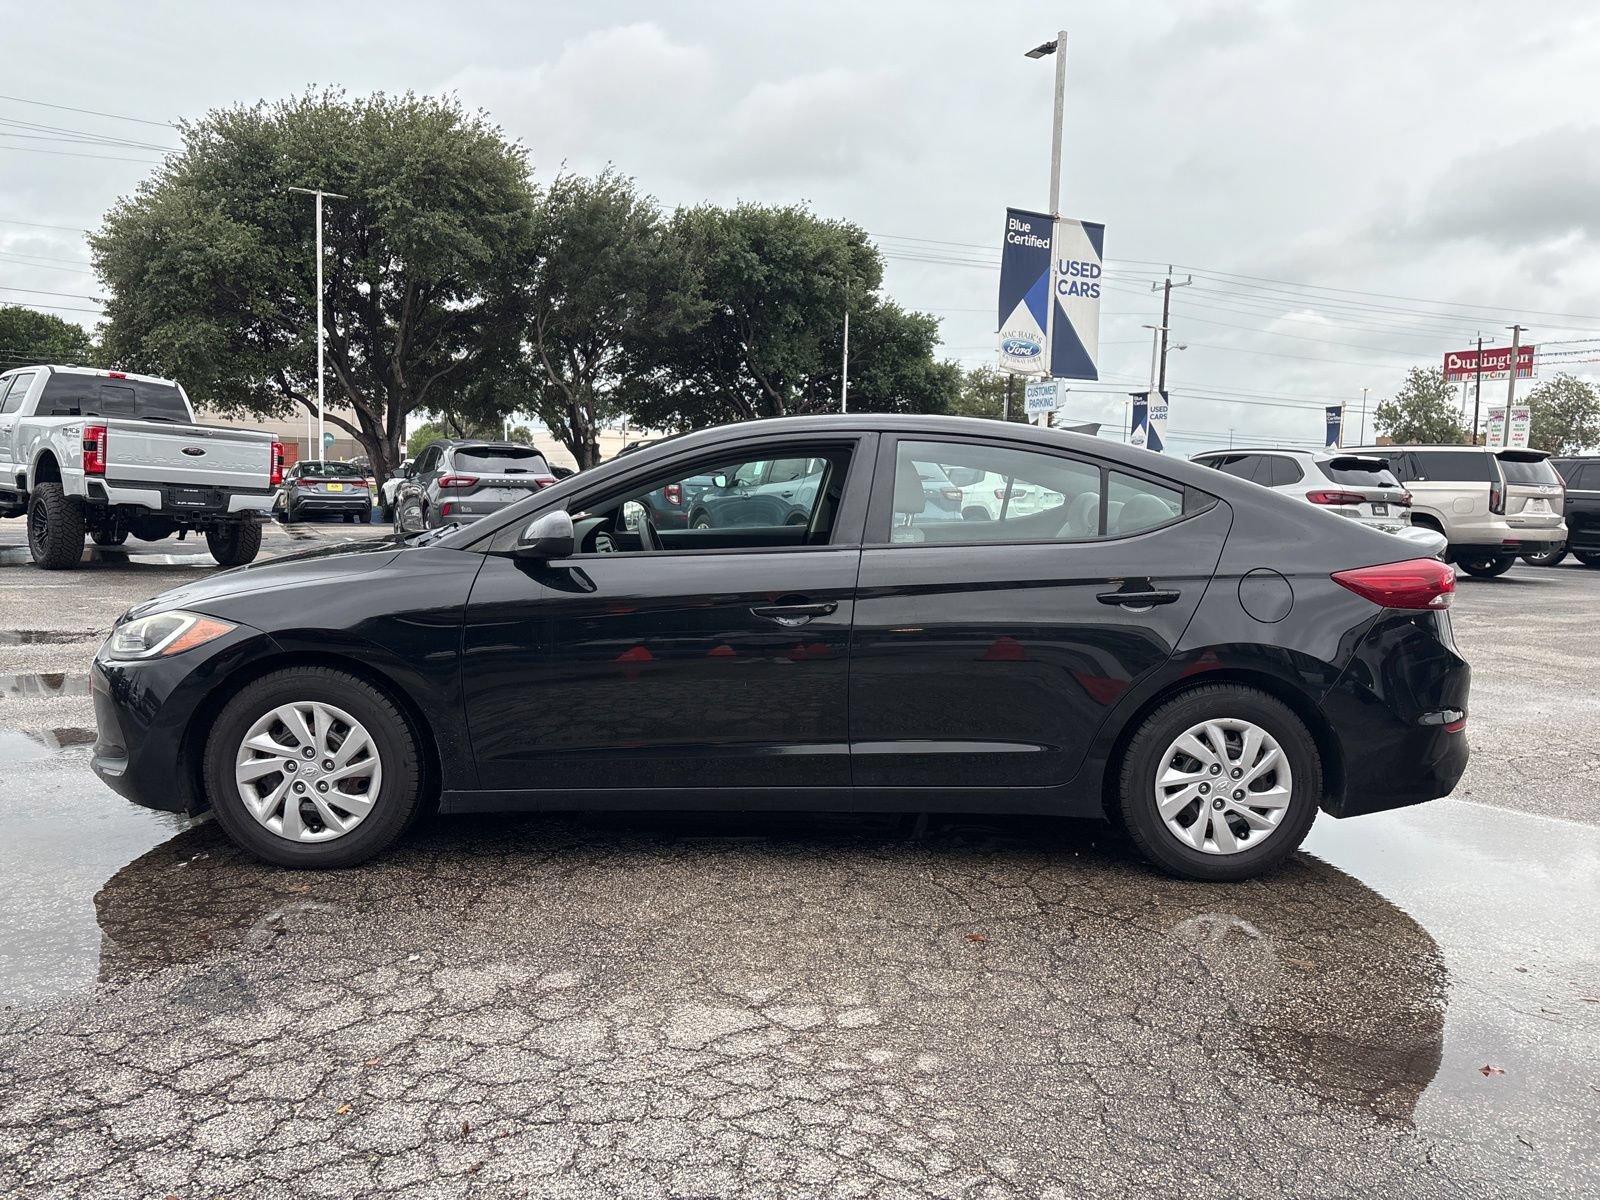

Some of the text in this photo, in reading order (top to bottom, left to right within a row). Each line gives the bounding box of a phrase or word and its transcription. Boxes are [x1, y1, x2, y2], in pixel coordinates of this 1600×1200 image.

[1008, 218, 1031, 232] Blue
[1007, 232, 1050, 249] Certified
[1059, 259, 1102, 279] USED
[1057, 279, 1101, 299] CARS
[1001, 330, 1016, 339] MAC
[1008, 341, 1033, 355] Ford
[1027, 385, 1057, 398] CUSTOMER
[1029, 397, 1054, 409] PARKING
[117, 454, 264, 471] SUPER DUTY
